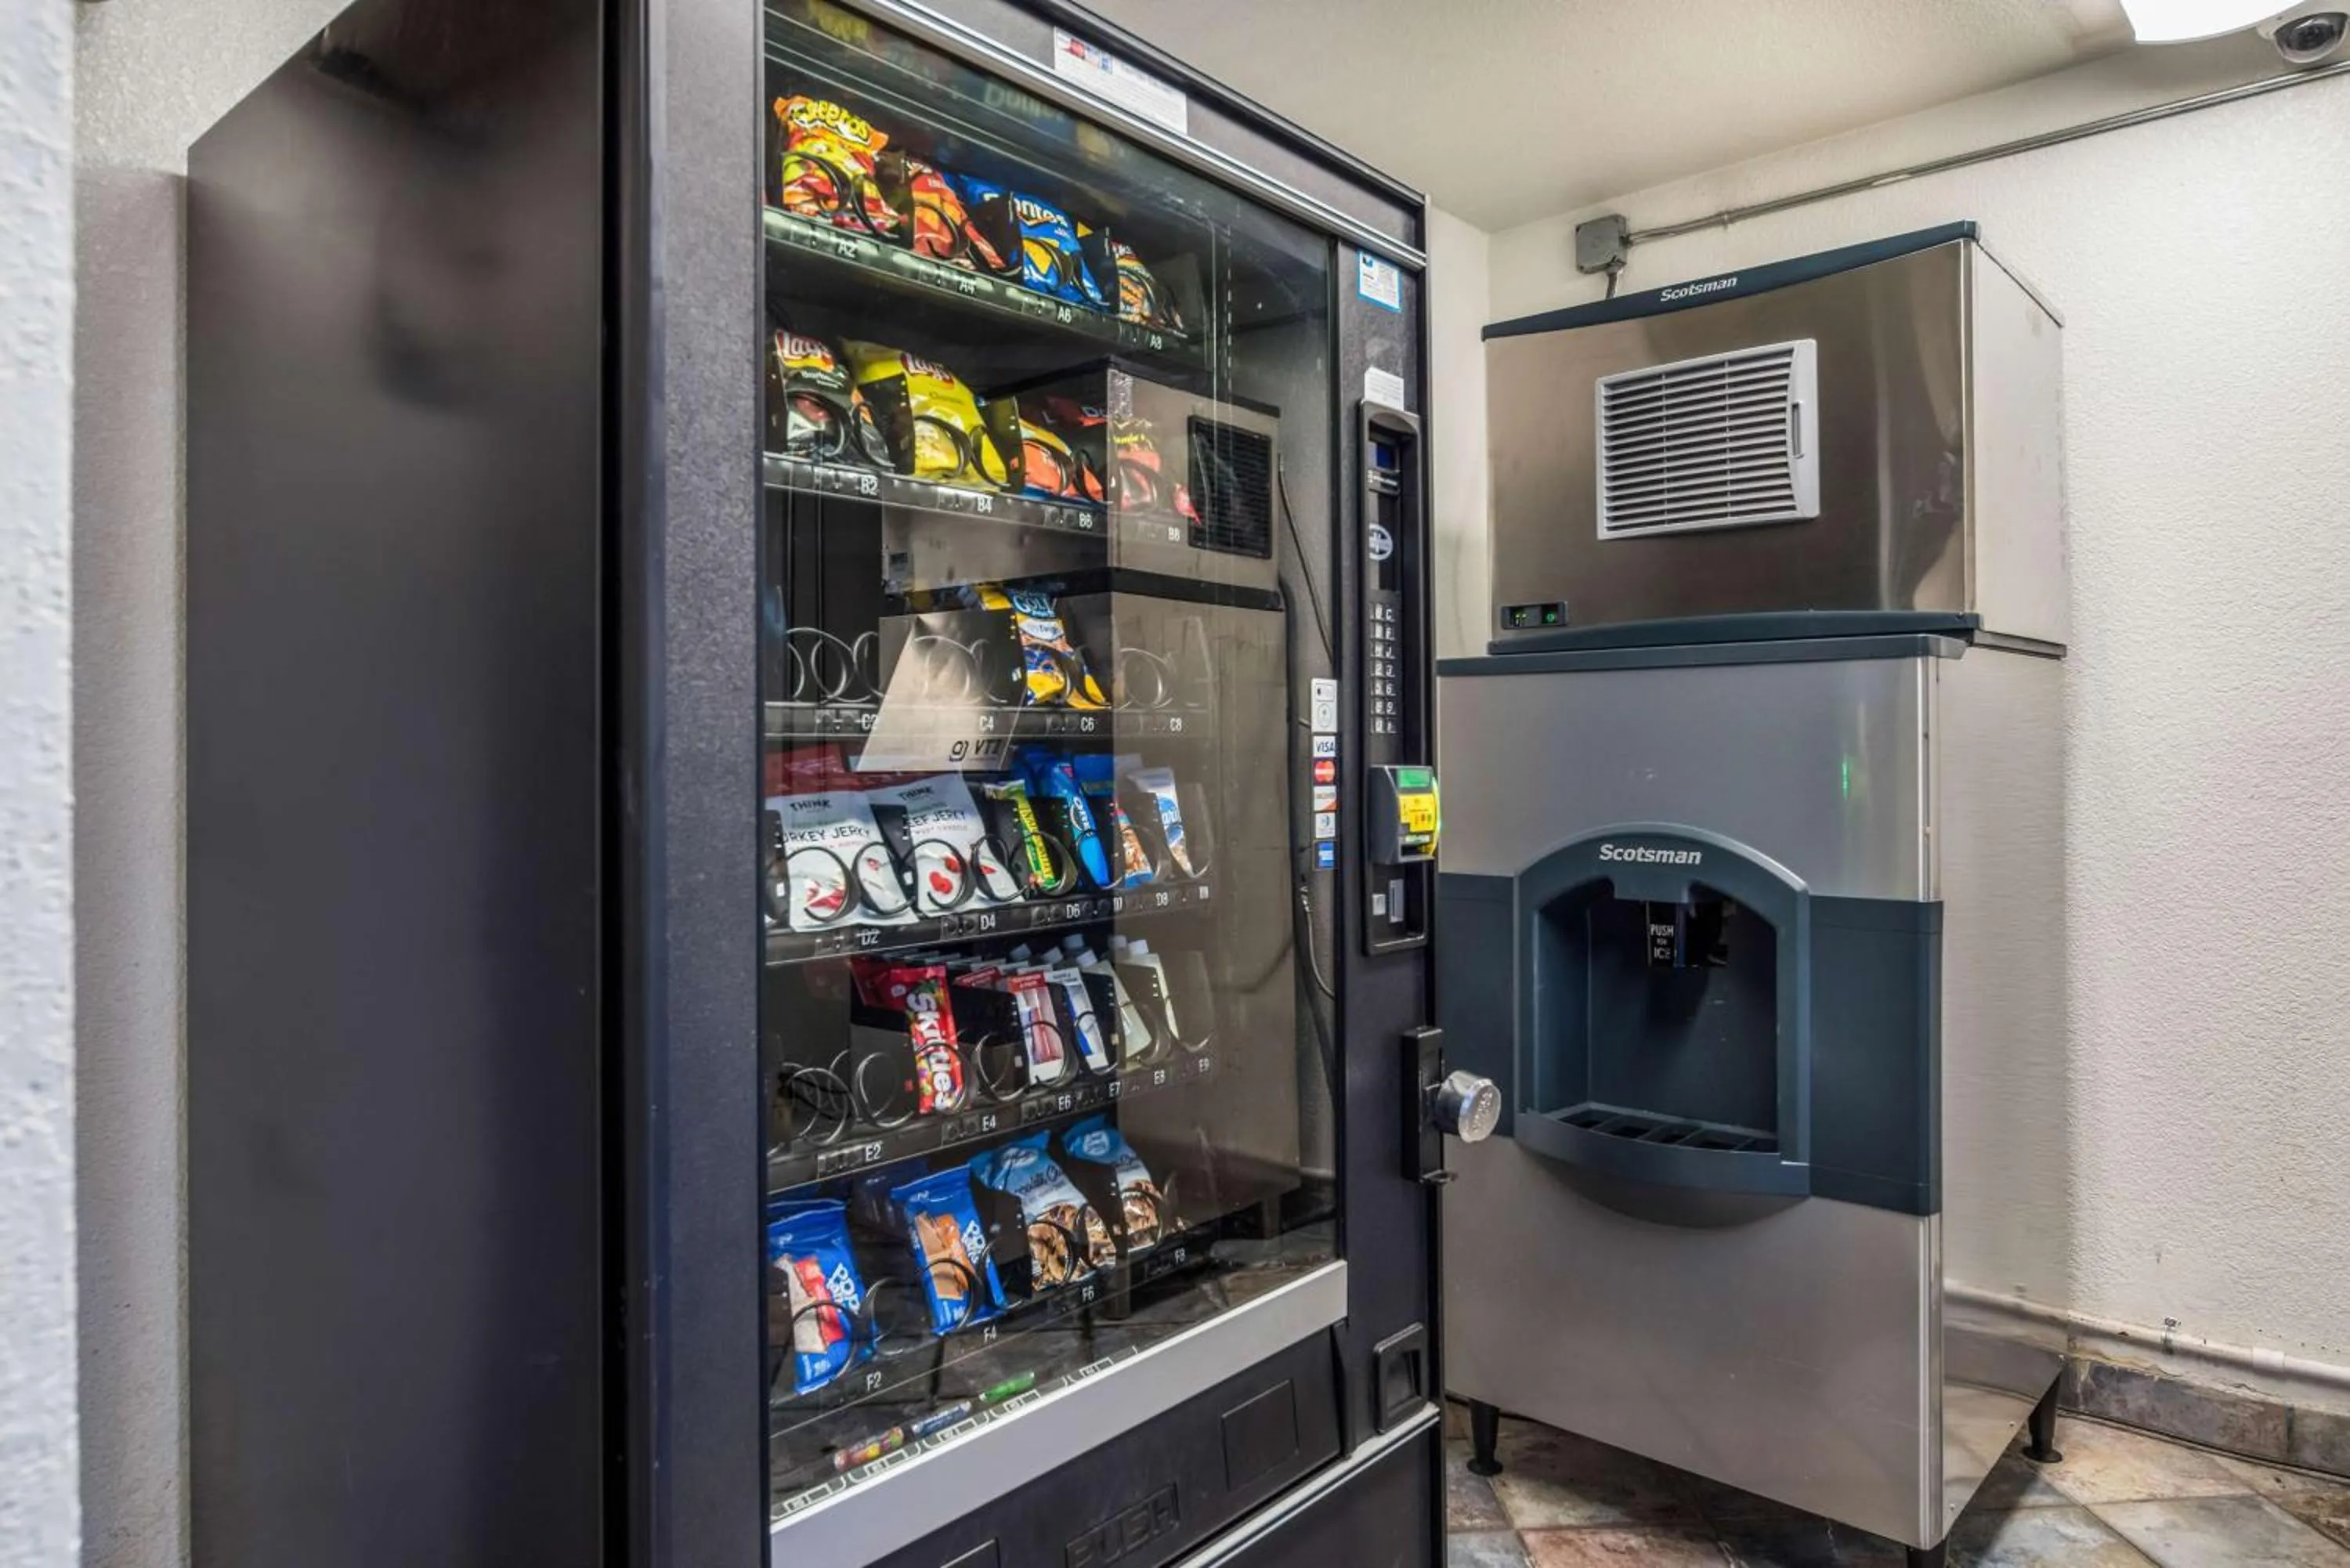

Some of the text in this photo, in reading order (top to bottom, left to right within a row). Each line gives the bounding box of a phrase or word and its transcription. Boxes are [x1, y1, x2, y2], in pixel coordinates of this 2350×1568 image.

[837, 241, 857, 258] A2
[959, 279, 975, 294] A4
[1660, 276, 1738, 302] Scotsman
[1058, 309, 1072, 323] A6
[861, 476, 878, 495] B2
[977, 497, 992, 512] B4
[979, 715, 994, 731] C4
[1080, 717, 1094, 732] C6
[1170, 717, 1182, 732] C8
[1316, 742, 1335, 752] VISA
[790, 799, 831, 811] THINK
[908, 808, 965, 828] EEF JERKY
[783, 826, 870, 843] URKEY JERKY
[1599, 844, 1702, 865] Scotsman
[1066, 904, 1080, 918] D6
[981, 915, 996, 929] D4
[1650, 924, 1675, 937] PUSH
[1654, 947, 1671, 959] ICE
[1058, 1097, 1072, 1111] E6
[982, 1115, 996, 1131] E4
[866, 1143, 882, 1161] E2
[1082, 1285, 1094, 1302] F6
[983, 1327, 997, 1342] F4
[866, 1372, 881, 1391] F2
